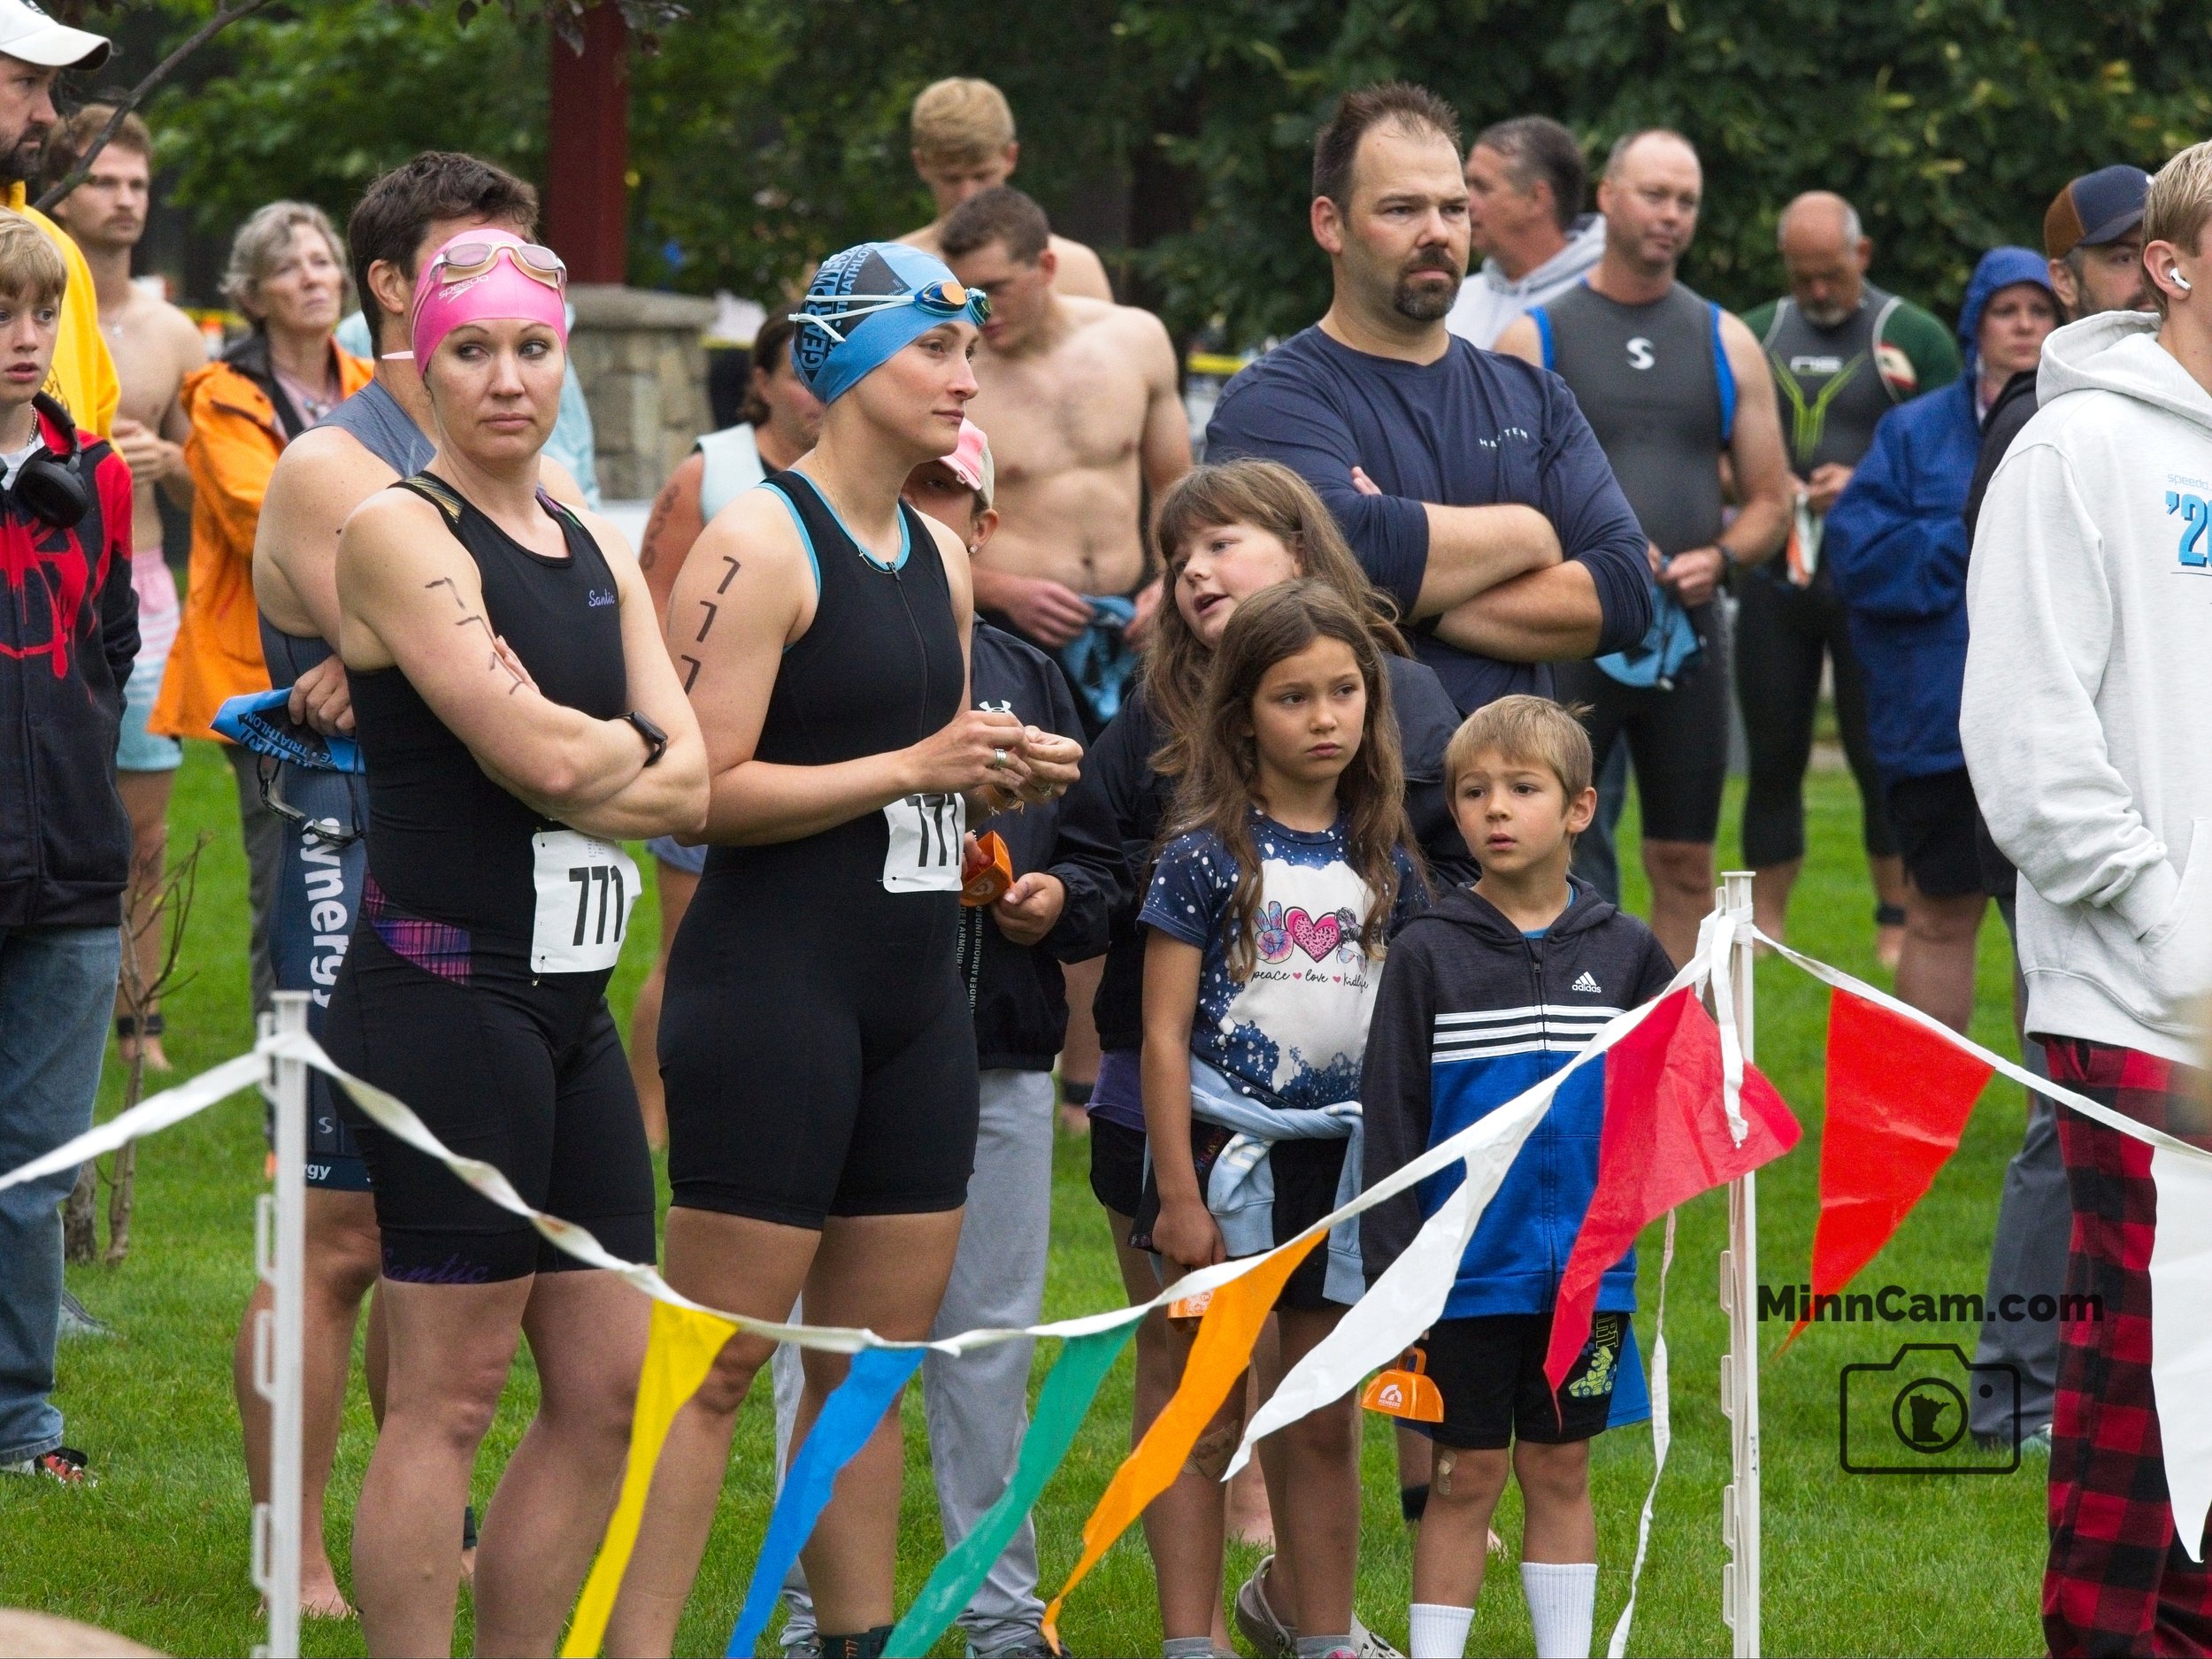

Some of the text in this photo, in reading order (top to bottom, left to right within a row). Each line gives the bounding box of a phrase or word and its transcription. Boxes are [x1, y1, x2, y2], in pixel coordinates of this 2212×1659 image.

[438, 275, 489, 299] speedo
[569, 864, 624, 947] 771
[958, 906, 967, 925] DER
[972, 938, 982, 976] ARMOUR
[1250, 971, 1291, 982] peace
[1305, 969, 1328, 982] love
[1571, 983, 1601, 993] adidas
